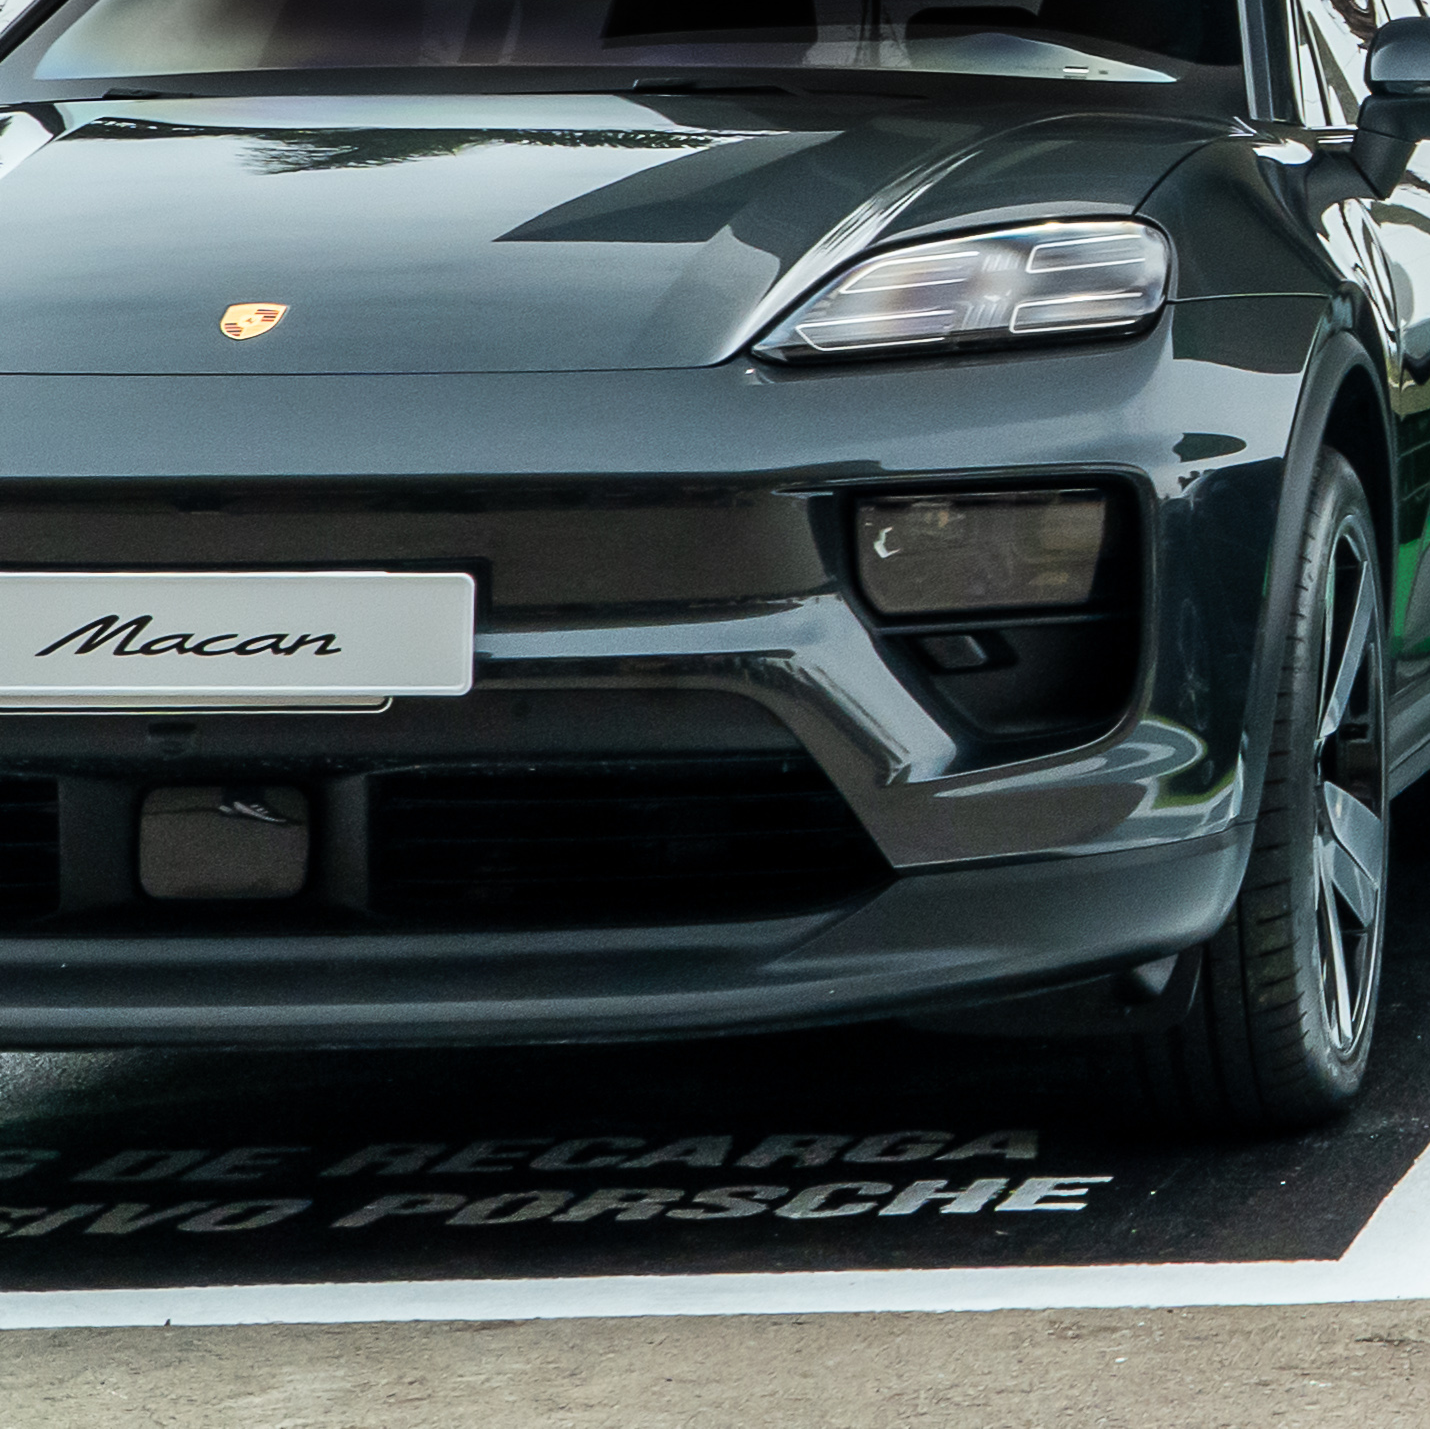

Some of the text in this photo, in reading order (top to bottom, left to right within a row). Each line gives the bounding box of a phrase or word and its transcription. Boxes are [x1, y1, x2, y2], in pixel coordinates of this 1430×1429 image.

[34, 614, 342, 657] Macan
[68, 1145, 312, 1183] DE
[318, 1128, 1040, 1177] RECARGA
[328, 1175, 1114, 1228] PORSCHE
